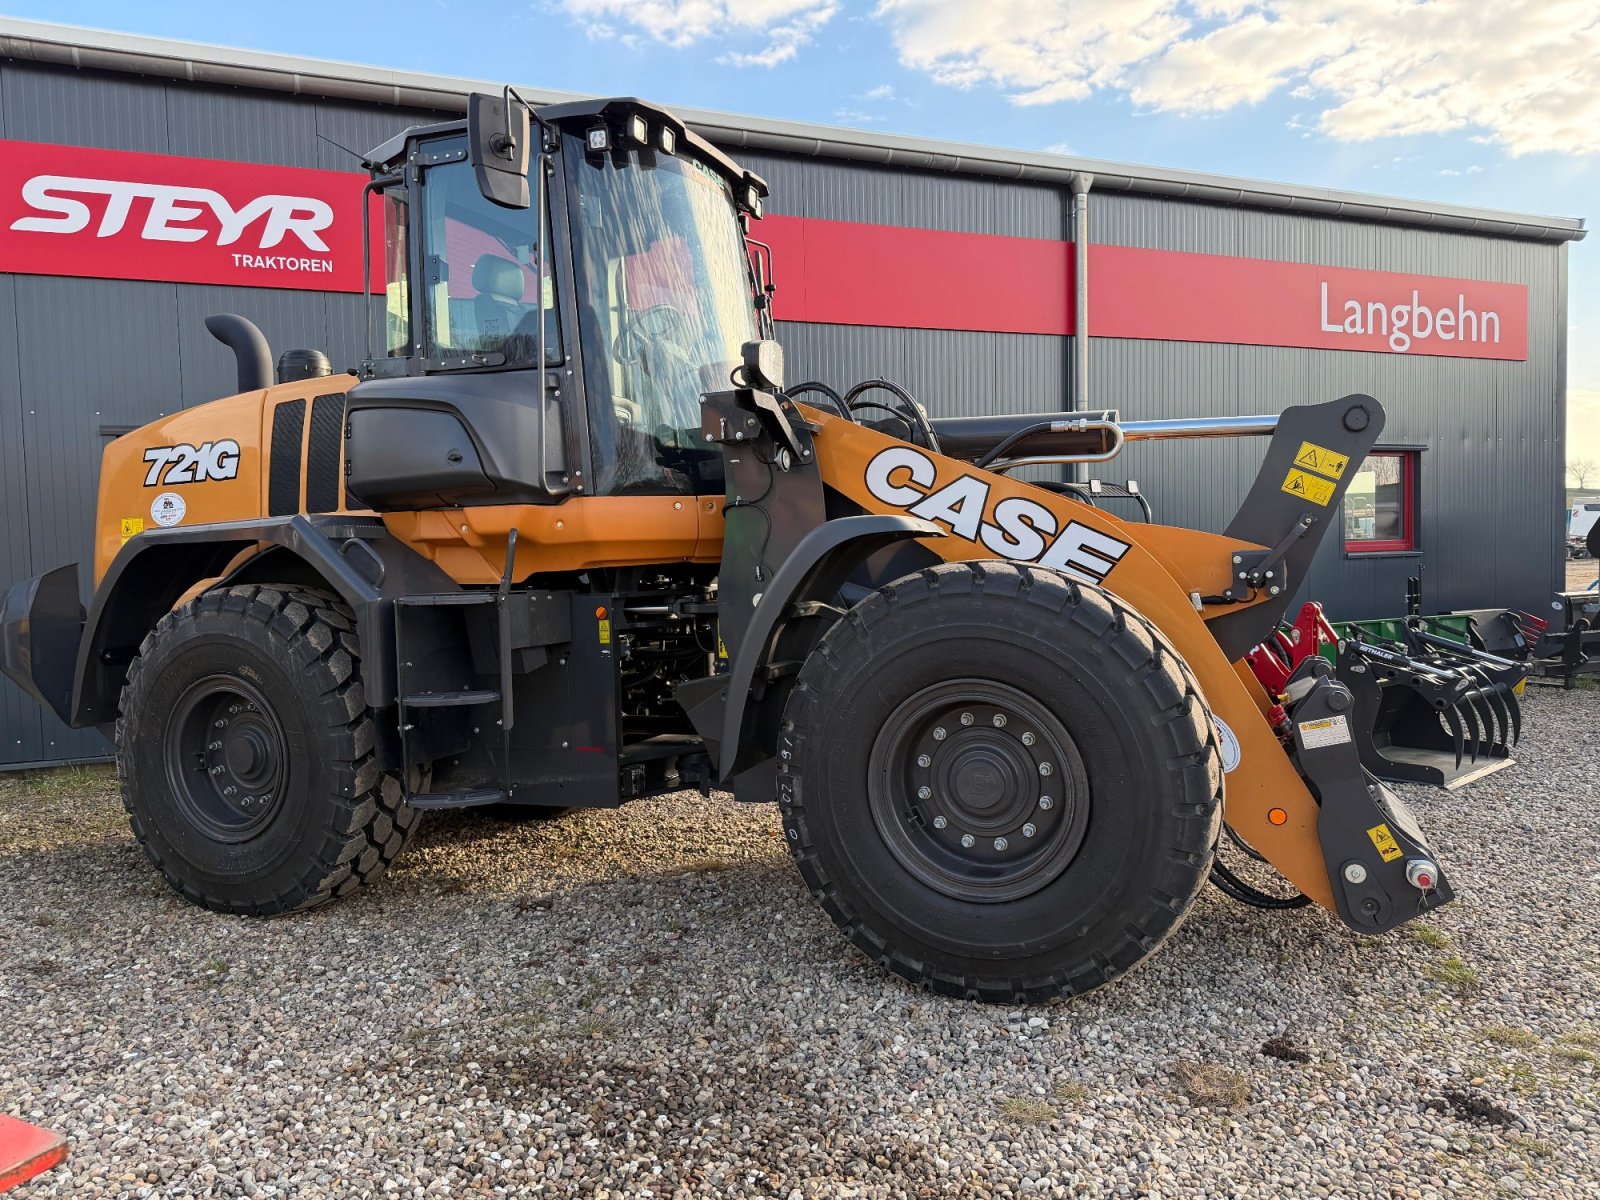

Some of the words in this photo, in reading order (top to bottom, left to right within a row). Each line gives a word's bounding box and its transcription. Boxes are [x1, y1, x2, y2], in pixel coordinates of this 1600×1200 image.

[691, 158, 725, 191] CASE
[9, 175, 334, 252] STEYR
[231, 253, 333, 273] TRAKTOREN
[1320, 281, 1500, 352] Langbehn
[143, 438, 241, 487] 721G
[864, 446, 1133, 585] CASE
